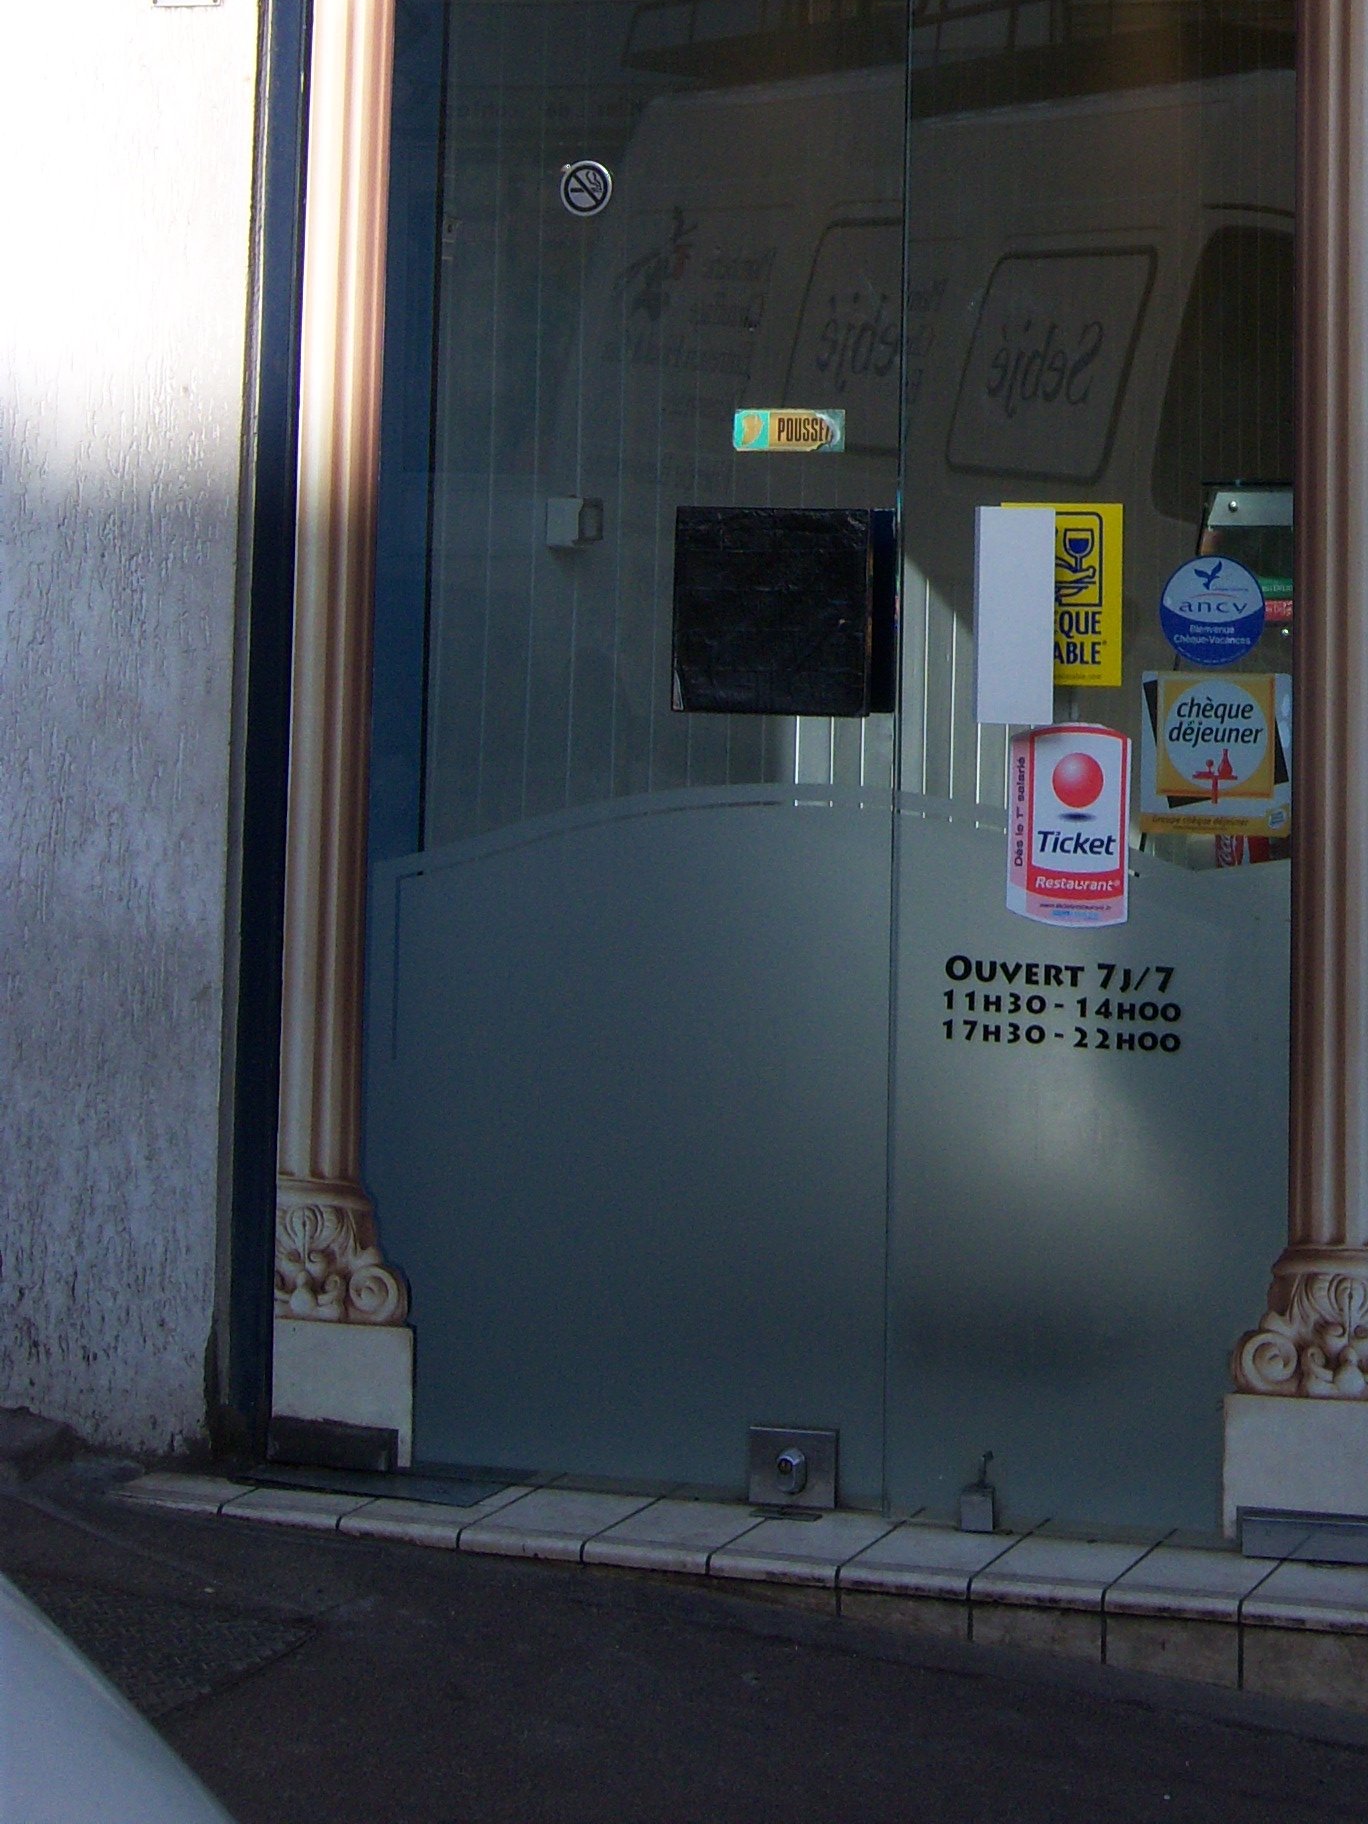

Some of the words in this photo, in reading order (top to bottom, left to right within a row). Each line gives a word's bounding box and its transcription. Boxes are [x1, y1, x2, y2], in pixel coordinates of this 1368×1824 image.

[1179, 601, 1248, 615] ancv
[1055, 610, 1103, 640] QUE
[1189, 624, 1235, 635] Bienvenue
[1054, 641, 1102, 665] ABLE
[1177, 696, 1254, 725] chèque
[1168, 721, 1264, 748] déjeuner
[1037, 830, 1117, 856] Ticket
[944, 955, 1085, 987] OUVERT
